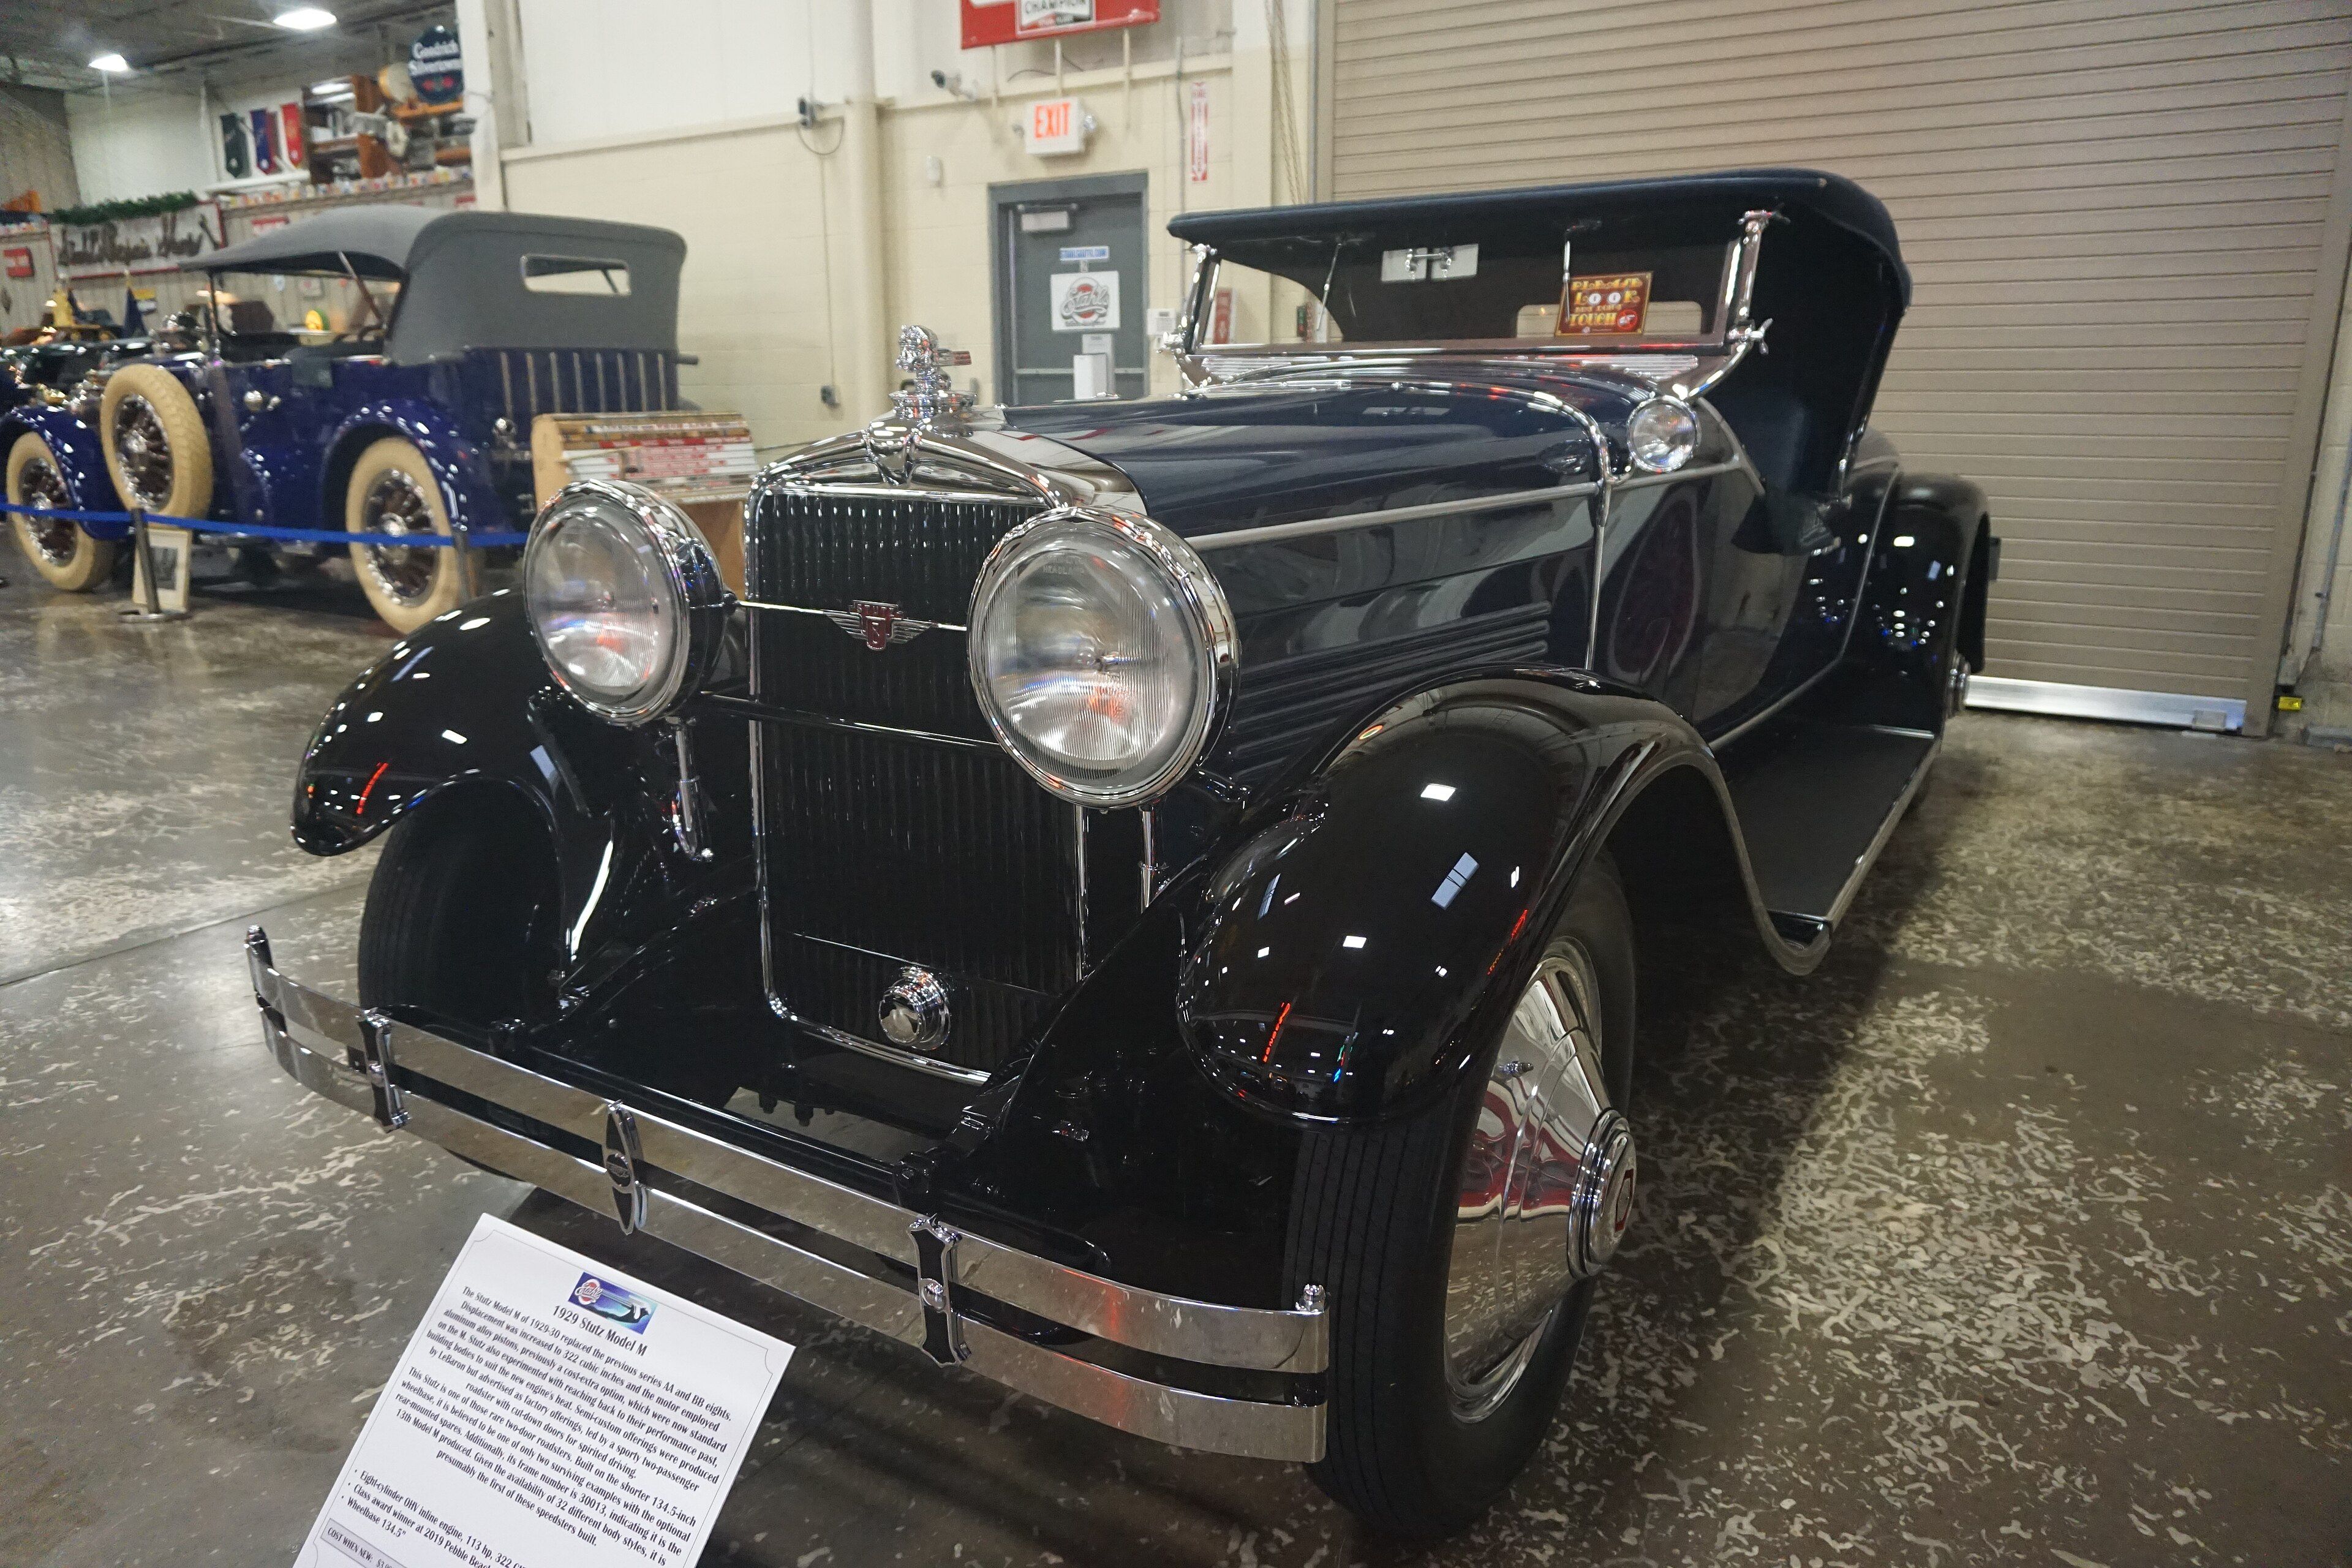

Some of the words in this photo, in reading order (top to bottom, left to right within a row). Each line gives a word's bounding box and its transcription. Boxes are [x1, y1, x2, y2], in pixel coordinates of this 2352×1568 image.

[1033, 102, 1070, 138] EXIT
[1569, 312, 1617, 326] TOUCH
[1570, 277, 1643, 291] PLEASE
[1574, 290, 1641, 305] LOOK
[857, 603, 895, 617] STUTZ
[461, 1301, 506, 1328] Displacement
[505, 1324, 519, 1335] was
[519, 1329, 555, 1351] increased
[554, 1346, 562, 1355] to
[562, 1349, 579, 1364] 322
[579, 1360, 600, 1374] cubic
[600, 1367, 625, 1386] inches
[625, 1382, 643, 1394] and
[642, 1388, 655, 1401] the
[655, 1396, 681, 1412] motor
[680, 1409, 721, 1432] employed
[462, 1286, 475, 1298] The
[475, 1292, 492, 1306] Stutz
[492, 1300, 514, 1316] Model
[513, 1310, 521, 1320] M
[530, 1319, 561, 1338] 1929-30
[560, 1335, 594, 1354] replaced
[592, 1348, 605, 1360] the
[604, 1356, 638, 1376] previous
[638, 1372, 663, 1388] series
[663, 1382, 674, 1393] AA
[674, 1389, 692, 1401] and
[692, 1395, 705, 1408] BB
[705, 1403, 731, 1422] eights.
[553, 1305, 579, 1324] 1929
[579, 1317, 605, 1338] Stutz
[605, 1329, 637, 1351] Model
[636, 1343, 648, 1357] M
[426, 1329, 454, 1351] building
[453, 1343, 475, 1360] bodies
[475, 1354, 484, 1364] to
[484, 1360, 499, 1371] suit
[498, 1366, 510, 1378] the
[510, 1374, 526, 1385] new
[526, 1381, 555, 1401] engine's
[554, 1394, 573, 1411] heat.
[575, 1404, 622, 1435] Semi-custom
[623, 1431, 658, 1453] offerings
[659, 1449, 679, 1464] were
[678, 1460, 720, 1484] produced
[429, 1346, 439, 1357] by
[438, 1351, 466, 1371] LeBaron
[466, 1365, 480, 1378] but
[478, 1373, 515, 1396] advertised
[514, 1392, 524, 1401] as
[524, 1395, 550, 1416] factory
[549, 1410, 583, 1434] offerings,
[585, 1427, 600, 1440] led
[598, 1433, 609, 1447] by
[609, 1441, 616, 1450] a
[616, 1445, 642, 1464] sporty
[642, 1457, 700, 1491] two-passenger
[438, 1321, 447, 1330] on
[447, 1325, 459, 1336] the
[459, 1330, 467, 1341] M.
[468, 1335, 486, 1349] Stutz
[485, 1345, 501, 1357] also
[501, 1353, 549, 1381] experimented
[548, 1376, 564, 1389] with
[564, 1384, 598, 1408] reaching
[597, 1399, 616, 1416] back
[617, 1409, 625, 1420] to
[626, 1414, 647, 1430] their
[645, 1426, 697, 1456] performance
[696, 1451, 718, 1468] past,
[443, 1309, 477, 1329] aluminum
[476, 1325, 494, 1339] alloy
[492, 1333, 519, 1352] pistons,
[519, 1347, 557, 1371] previously
[564, 1368, 600, 1390] cost-extra
[600, 1386, 625, 1405] option,
[628, 1399, 651, 1415] which
[652, 1411, 671, 1426] were
[671, 1421, 690, 1434] now
[689, 1430, 728, 1453] standard
[396, 1408, 412, 1423] 13th
[412, 1417, 434, 1434] Model
[432, 1428, 440, 1438] M
[438, 1434, 473, 1458] produced.
[474, 1452, 494, 1469] Given
[494, 1464, 507, 1477] the
[507, 1472, 546, 1500] availability
[546, 1494, 557, 1504] of
[556, 1498, 568, 1511] 32
[568, 1506, 603, 1530] different
[601, 1523, 622, 1543] body
[622, 1537, 647, 1558] styles,
[650, 1550, 658, 1561] it
[658, 1554, 666, 1566] is
[401, 1380, 435, 1405] wheelbase,
[436, 1397, 443, 1408] it
[442, 1401, 450, 1411] is
[450, 1405, 479, 1427] believed
[478, 1421, 486, 1431] to
[486, 1425, 496, 1437] be
[497, 1433, 510, 1444] one
[511, 1441, 521, 1450] of
[520, 1446, 537, 1460] only
[536, 1453, 550, 1466] two
[551, 1462, 586, 1487] surviving
[586, 1481, 622, 1506] examples
[623, 1501, 641, 1515] with
[641, 1509, 655, 1523] the
[656, 1519, 692, 1542] optional
[409, 1366, 423, 1380] This
[423, 1374, 440, 1390] Stutz
[440, 1383, 447, 1393] is
[448, 1390, 461, 1401] one
[461, 1396, 470, 1405] of
[469, 1400, 489, 1415] those
[489, 1411, 505, 1424] rare
[505, 1419, 537, 1441] two-door
[536, 1437, 573, 1462] roadsters.
[575, 1455, 594, 1472] Built
[594, 1468, 605, 1479] on
[606, 1473, 619, 1487] the
[620, 1482, 650, 1502] shorter
[652, 1497, 696, 1528] 134.5-inch
[328, 1527, 344, 1542] COST
[342, 1536, 360, 1553] WHEN
[358, 1547, 373, 1562] NEW:
[347, 1496, 381, 1525] Wheelbase
[353, 1484, 372, 1501] Class
[371, 1497, 393, 1514] award
[392, 1509, 416, 1528] winner
[415, 1525, 424, 1534] at
[423, 1528, 445, 1546] 2019
[443, 1540, 469, 1561] Pebble
[469, 1555, 492, 1568] Bea
[360, 1470, 404, 1503] Eight-cylinder
[404, 1497, 420, 1512] OHV
[418, 1506, 439, 1525] inline
[439, 1521, 463, 1543] engine,
[466, 1536, 482, 1551] 113
[481, 1544, 492, 1561] hp,
[495, 1553, 512, 1568] 322
